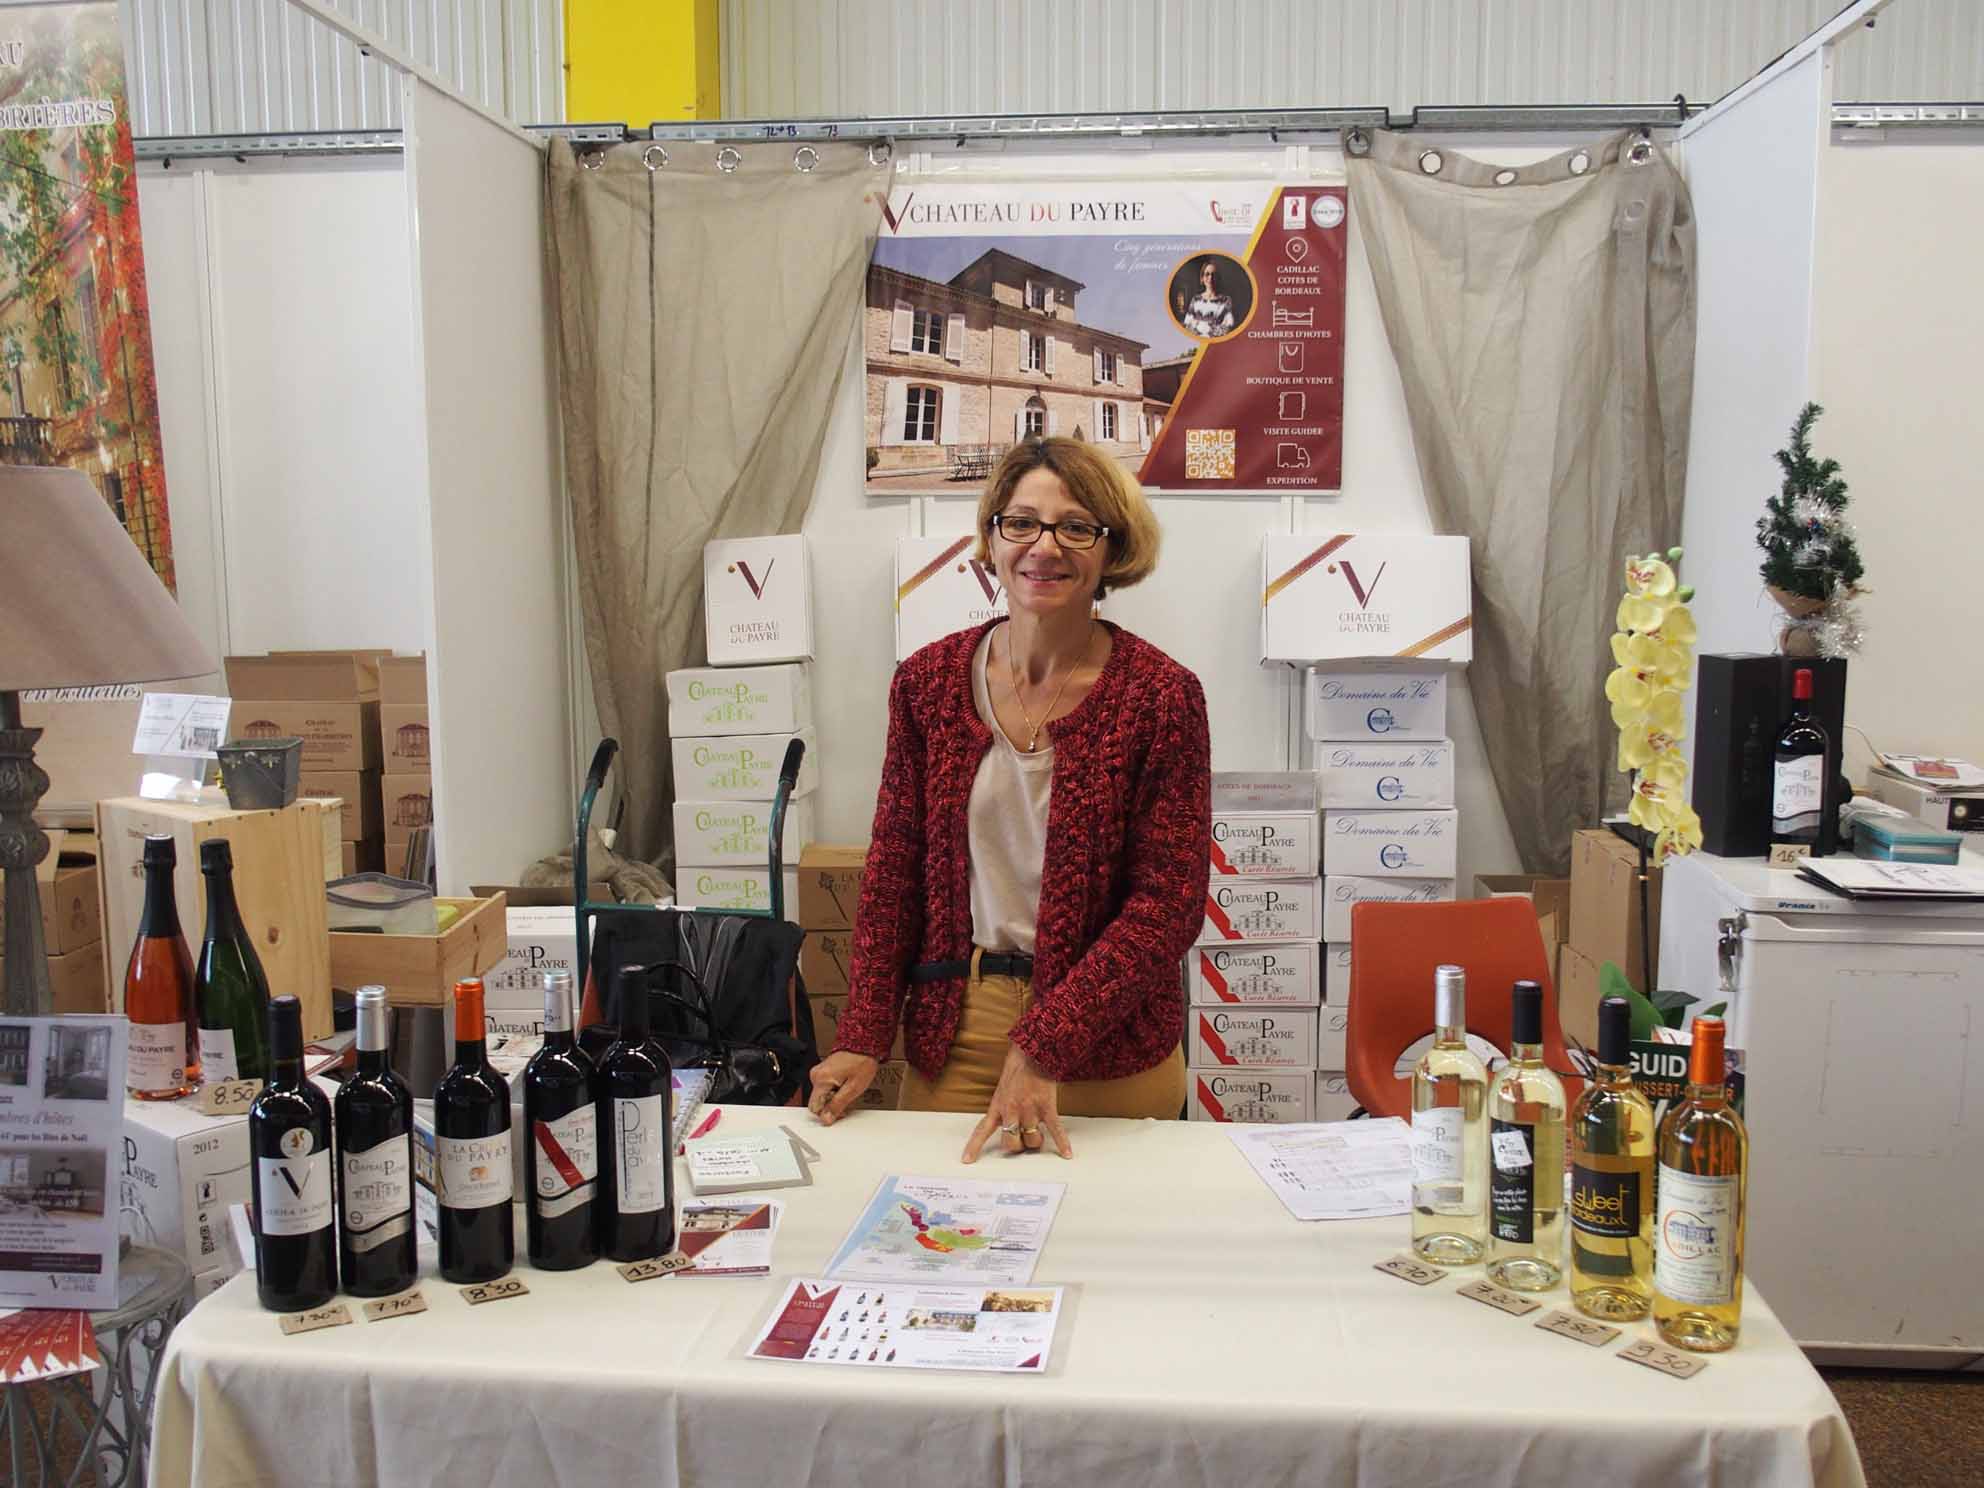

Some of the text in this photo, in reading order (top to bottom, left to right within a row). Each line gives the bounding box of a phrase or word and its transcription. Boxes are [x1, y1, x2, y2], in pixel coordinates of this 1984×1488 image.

[910, 202, 1020, 223] CHATEAU
[1029, 203, 1061, 222] DU
[1070, 201, 1145, 221] PAYRE
[1276, 265, 1320, 273] CADILLAC
[1307, 276, 1319, 285] DE
[1275, 287, 1321, 296] BORDEAUX
[1247, 330, 1294, 338] CHAMBRES
[1246, 377, 1334, 386] BOUTIQUE DE VENTE
[1263, 427, 1290, 435] VISITE
[1266, 476, 1318, 485] EXPEDITION
[1338, 612, 1391, 623] CHATEAU
[729, 621, 780, 634] CHATEAU
[1356, 623, 1391, 633] PAYRE
[747, 632, 780, 642] PAYRE
[1260, 826, 1296, 847] PAYRE
[1265, 891, 1299, 911] PAYRE
[530, 946, 568, 968] PAYRE
[1262, 955, 1296, 976] PAYRE
[1260, 1019, 1294, 1039] PAYRE
[1629, 1051, 1688, 1077] GUID
[1258, 1082, 1291, 1102] PAYRE
[194, 1139, 220, 1155] 2012
[124, 1136, 158, 1189] PAYRE
